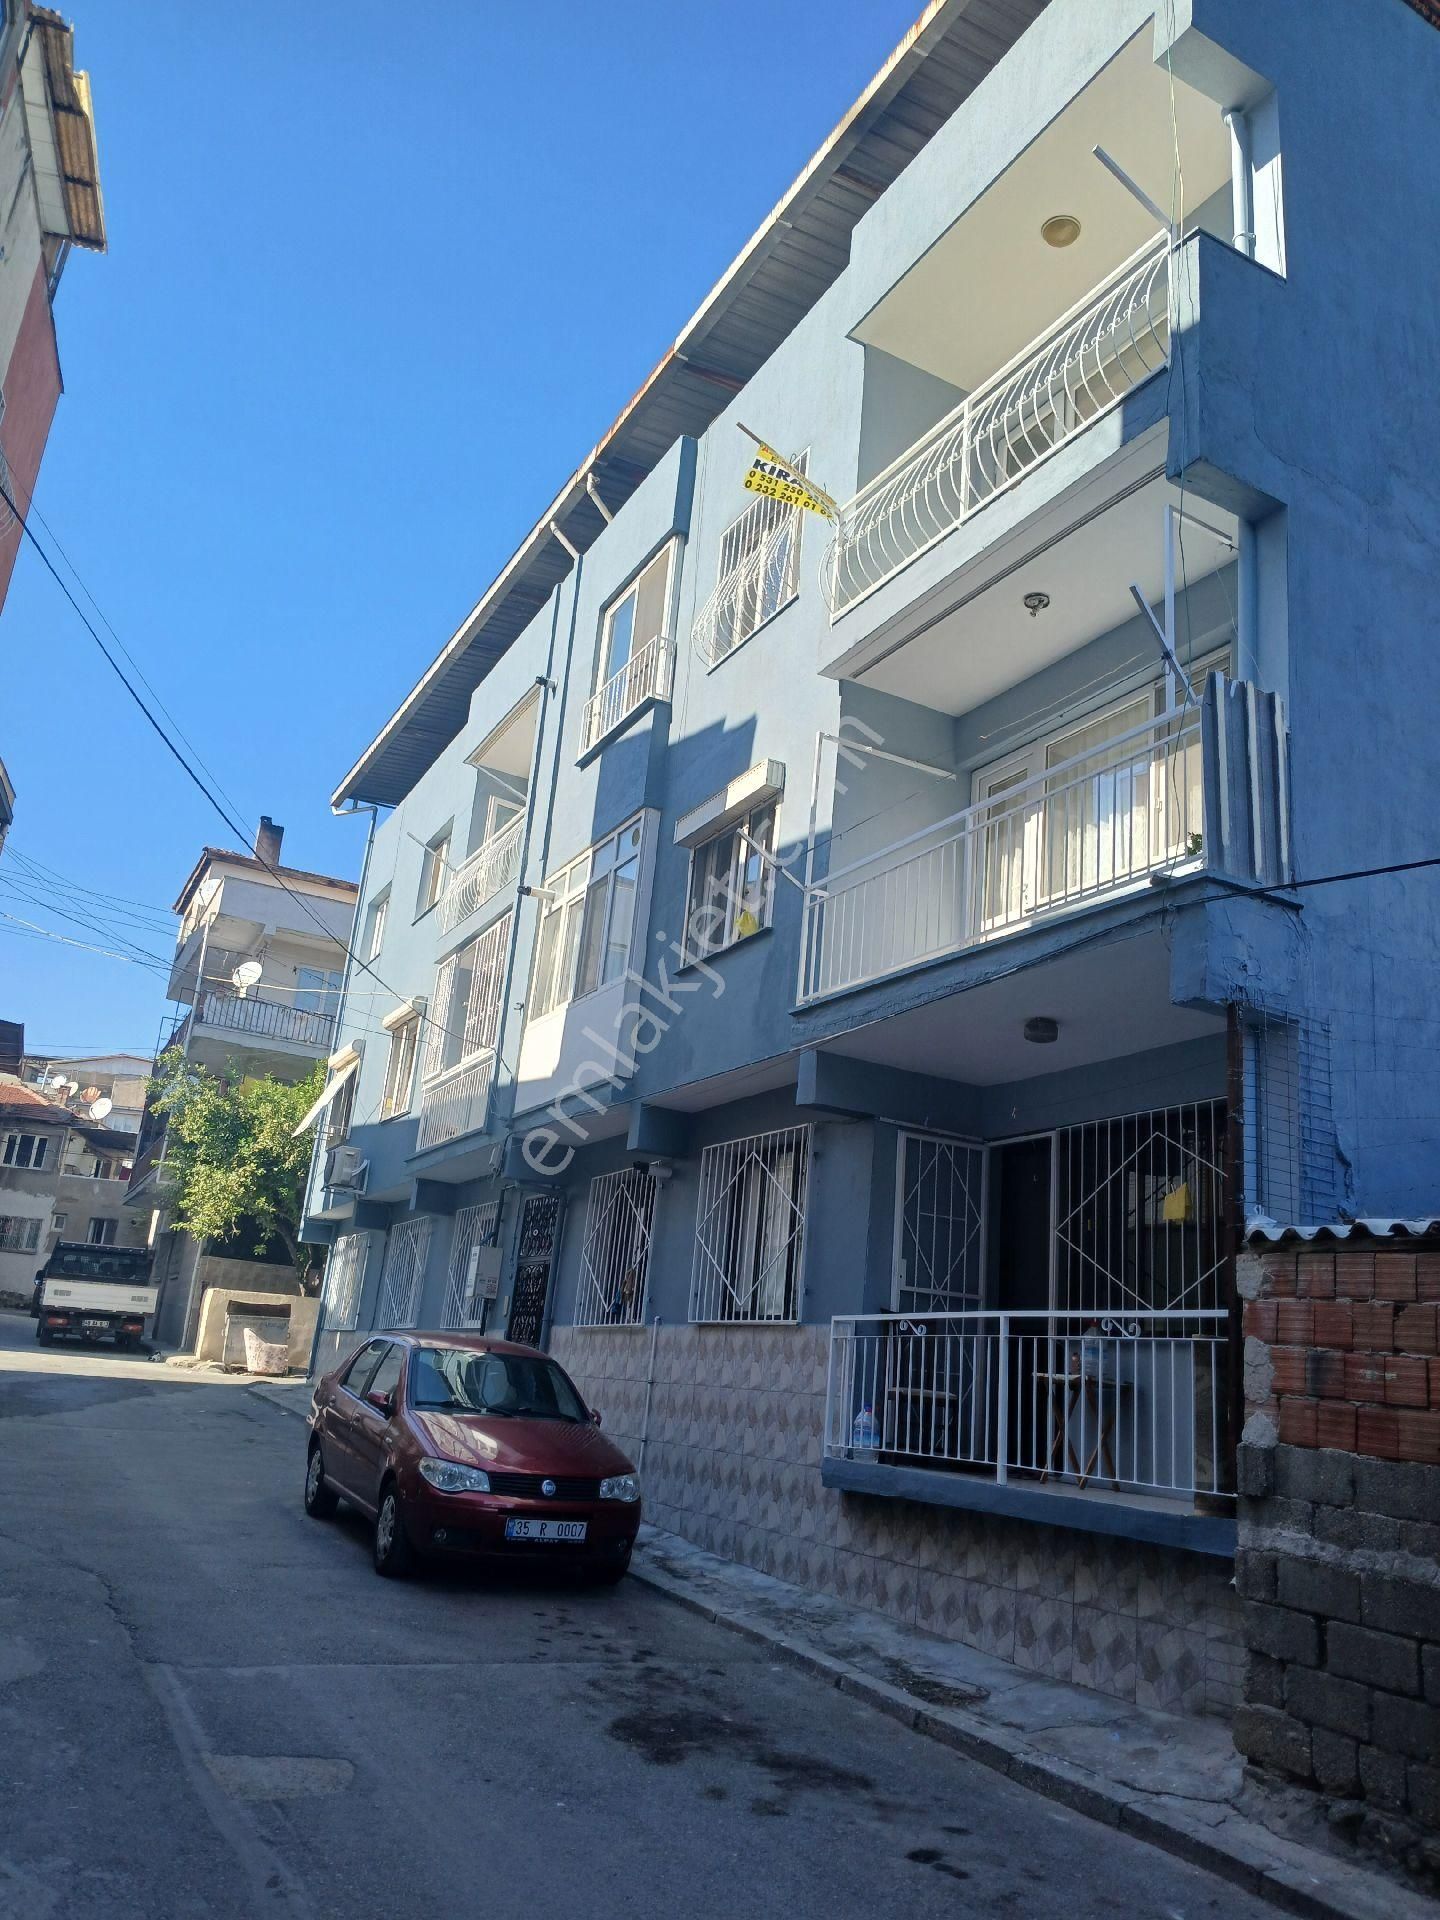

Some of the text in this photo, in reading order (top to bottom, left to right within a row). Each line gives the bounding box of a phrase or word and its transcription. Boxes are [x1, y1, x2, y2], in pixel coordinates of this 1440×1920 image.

[745, 480, 752, 488] 0
[755, 484, 776, 496] 232
[779, 493, 800, 504] 261
[803, 501, 816, 510] 01
[749, 470, 756, 478] 0
[759, 474, 779, 486] 531
[783, 484, 803, 496] 250
[515, 1521, 584, 1537] 35 R 0007
